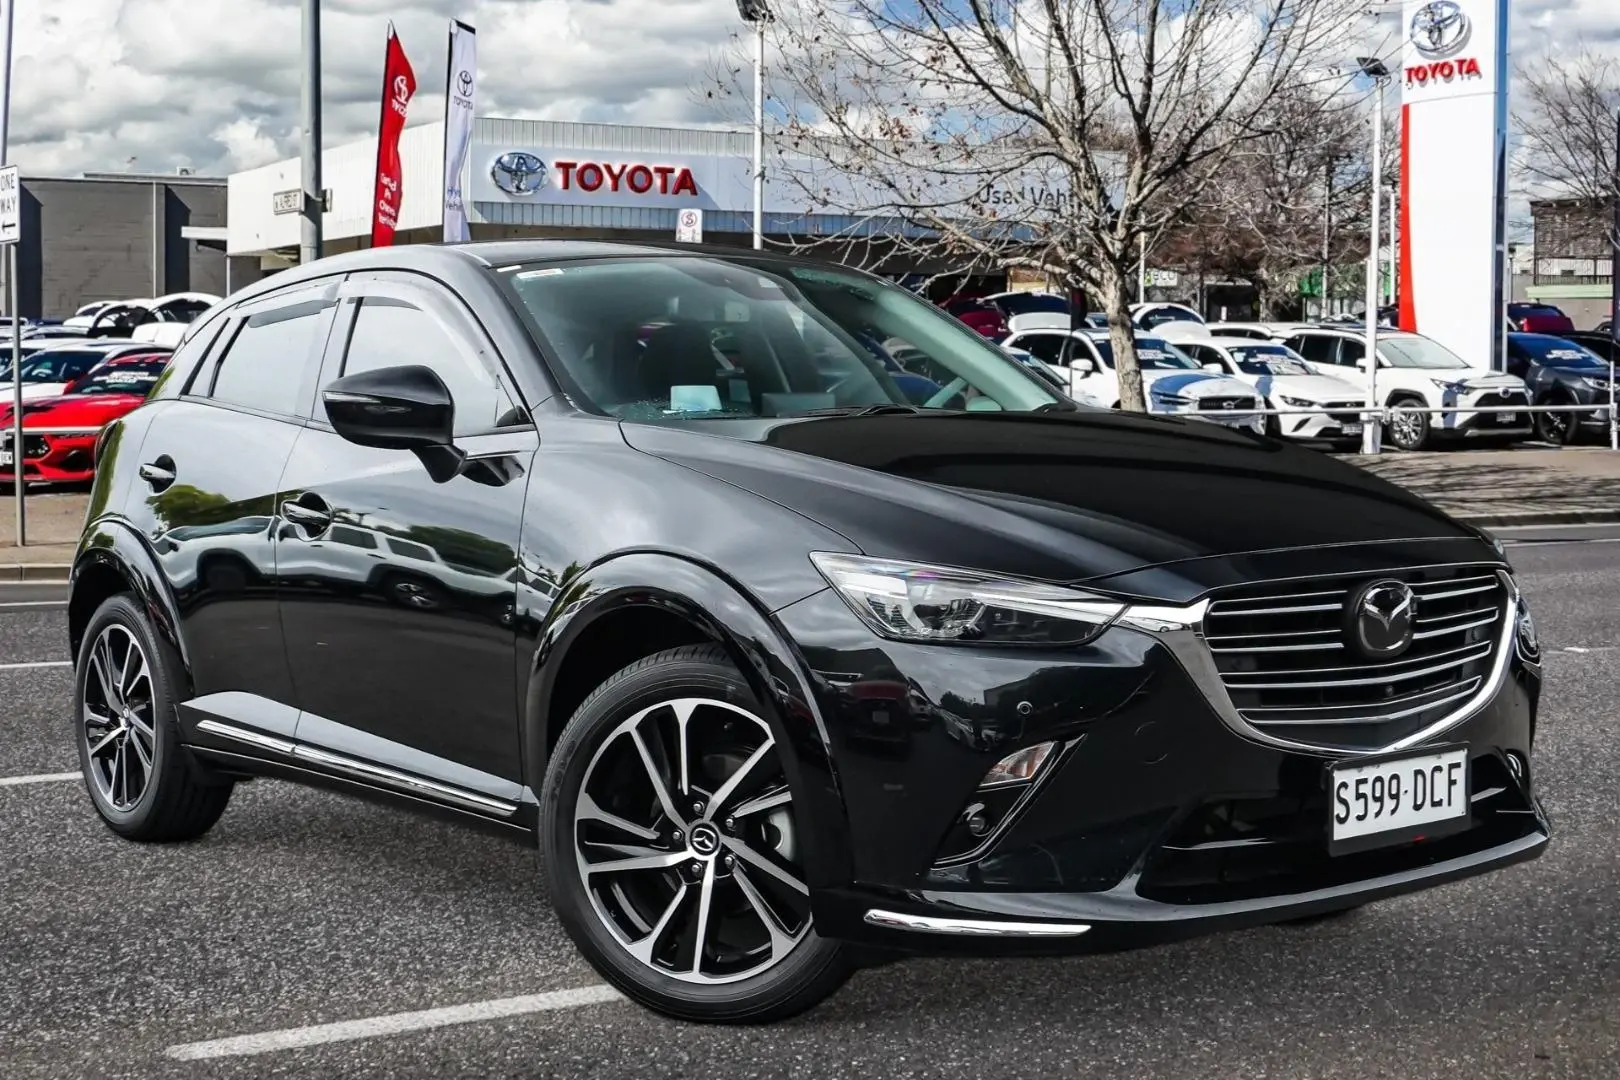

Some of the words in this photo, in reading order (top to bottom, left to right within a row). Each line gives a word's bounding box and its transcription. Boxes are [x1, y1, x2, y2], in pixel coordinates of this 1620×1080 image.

[1404, 58, 1480, 83] TOYOTA
[555, 161, 698, 196] TOYOTA
[1, 196, 16, 213] WAY
